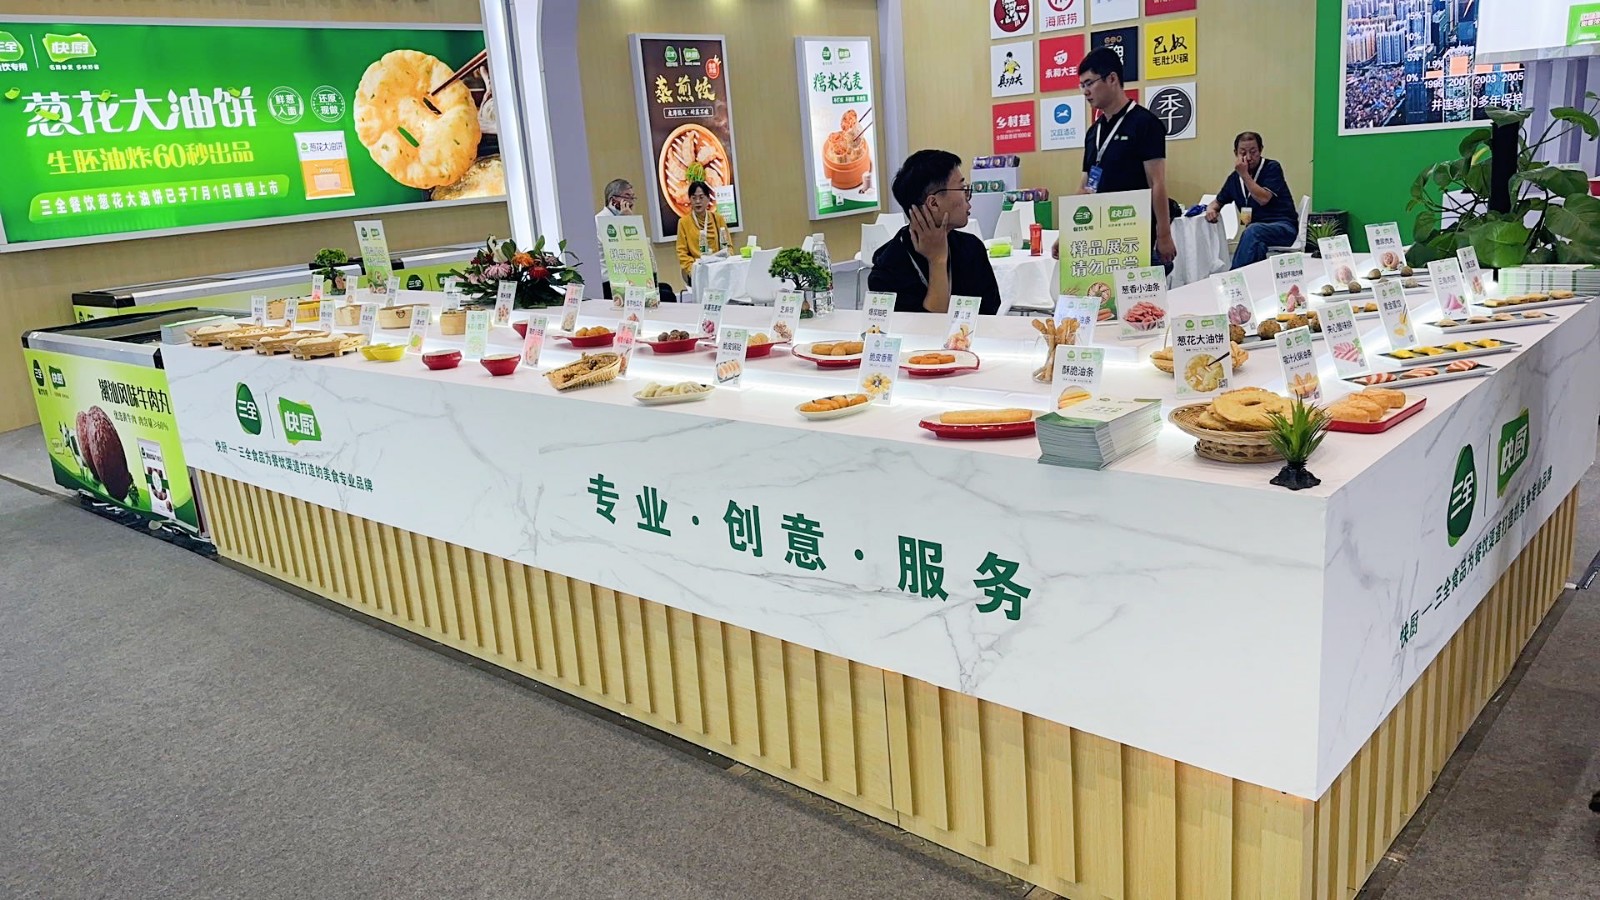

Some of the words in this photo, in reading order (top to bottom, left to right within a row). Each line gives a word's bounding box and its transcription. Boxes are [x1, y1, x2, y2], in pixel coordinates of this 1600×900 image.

[1046, 13, 1077, 28] 海底捞
[51, 41, 89, 54] 快厨
[0, 62, 28, 71] 饮专用
[1153, 53, 1189, 66] 毛肚火锅
[1045, 66, 1078, 78] 永和大王
[1406, 74, 1419, 82] 0%
[1475, 75, 1497, 84] 2003
[1502, 72, 1524, 82] 2005
[655, 74, 715, 103] 蒸煎饺
[813, 72, 863, 92] 糯米烧麦
[998, 74, 1023, 88] 真功夫
[1431, 92, 1524, 111] 并连续10多年保持
[22, 87, 257, 137] 葱花大油饼
[1156, 93, 1184, 134] 季
[996, 113, 1031, 129] 乡村基
[47, 141, 254, 174] 生胚油炸60秒出品
[40, 180, 279, 216] 三全餐饮葱花大油饼已于7月1日重磅上市
[1111, 208, 1133, 218] 快厨
[1070, 237, 1139, 258] 样品展示
[1071, 256, 1139, 277] 请勿品尝
[1122, 283, 1160, 295] 葱香小油条
[1177, 334, 1224, 347] 葱花大油饼
[869, 352, 893, 363] 脆皮香蕉
[1061, 364, 1094, 377] 酥脆油条
[98, 378, 172, 415] 潮汕风味牛肉丸
[238, 399, 258, 421] 三全
[284, 411, 316, 436] 快厨
[1500, 423, 1528, 475] 快厨
[1450, 470, 1474, 520] 三全
